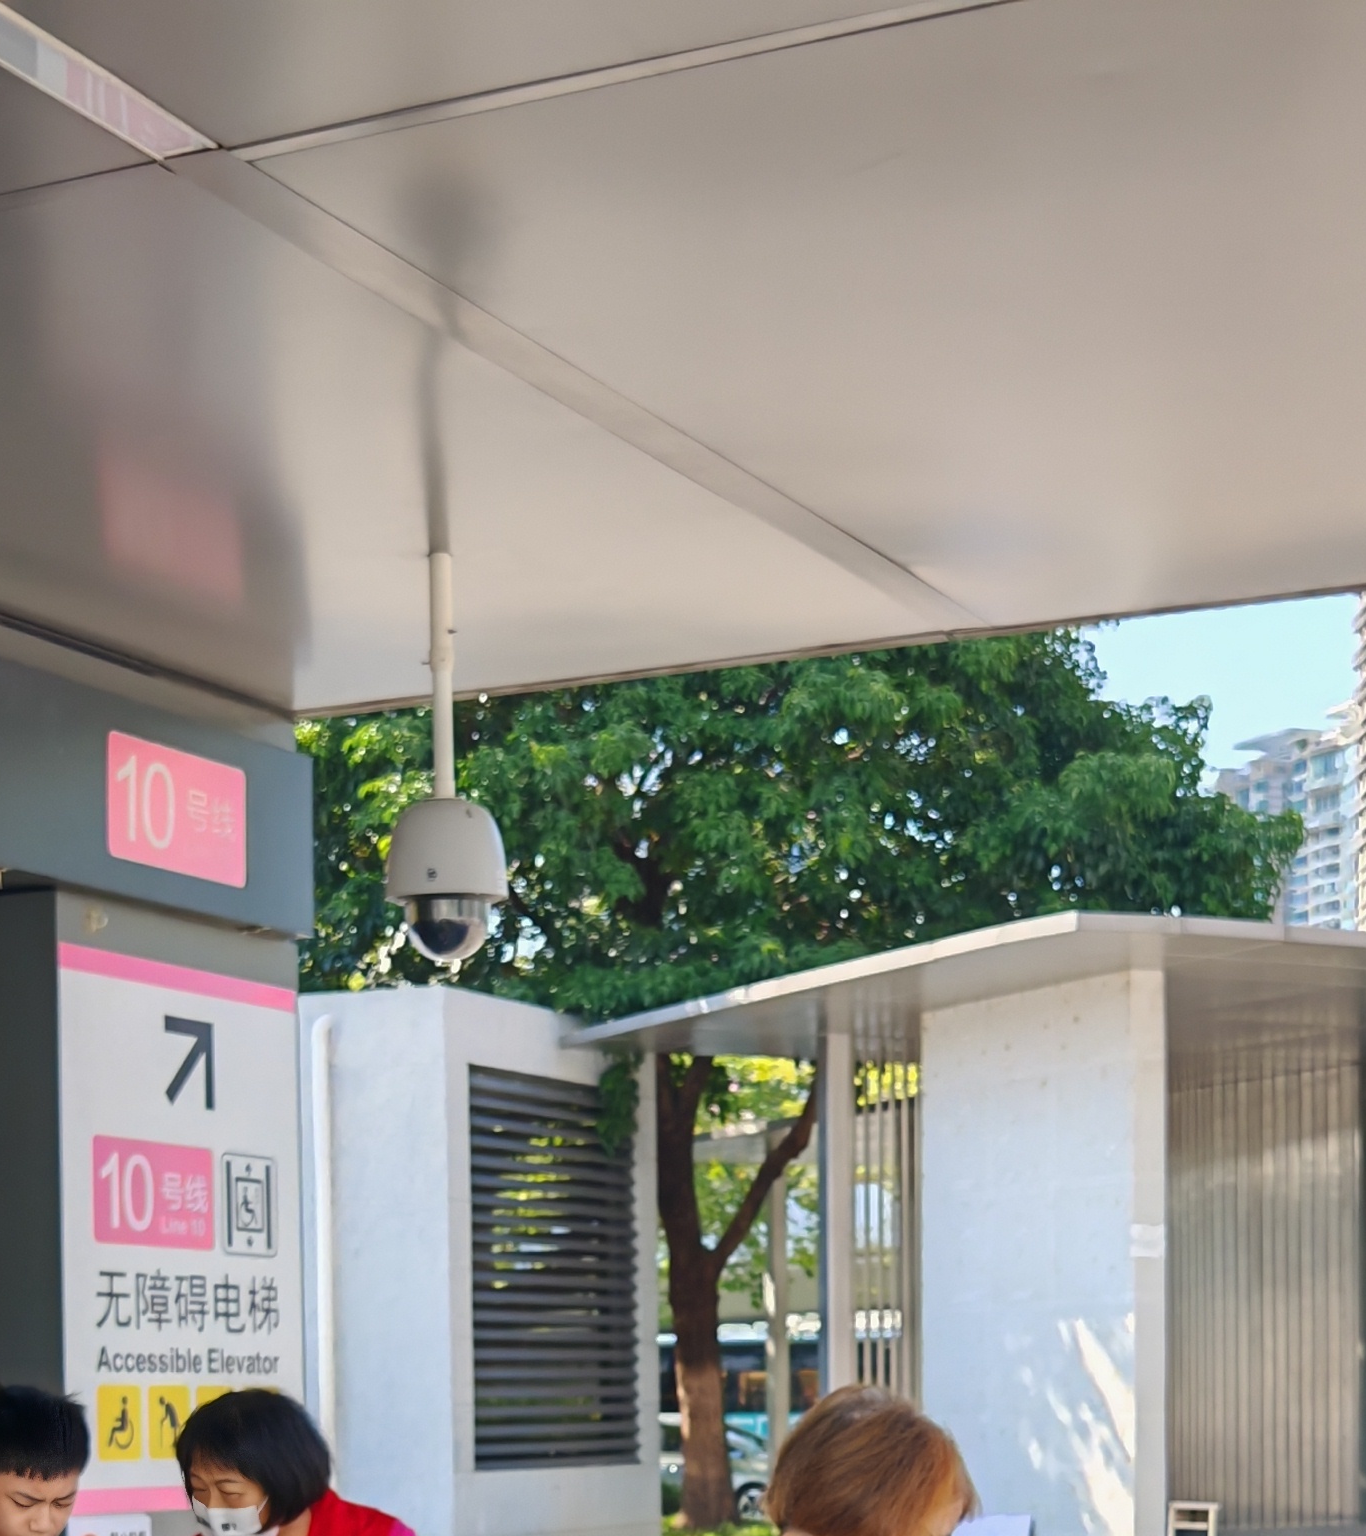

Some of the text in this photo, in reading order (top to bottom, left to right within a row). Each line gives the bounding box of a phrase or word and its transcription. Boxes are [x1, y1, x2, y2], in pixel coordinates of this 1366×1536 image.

[116, 754, 176, 850] 10
[99, 1151, 209, 1232] 10 号线
[95, 1268, 281, 1336] 无障碍电梯
[96, 1346, 280, 1375] Accessible Elevator
